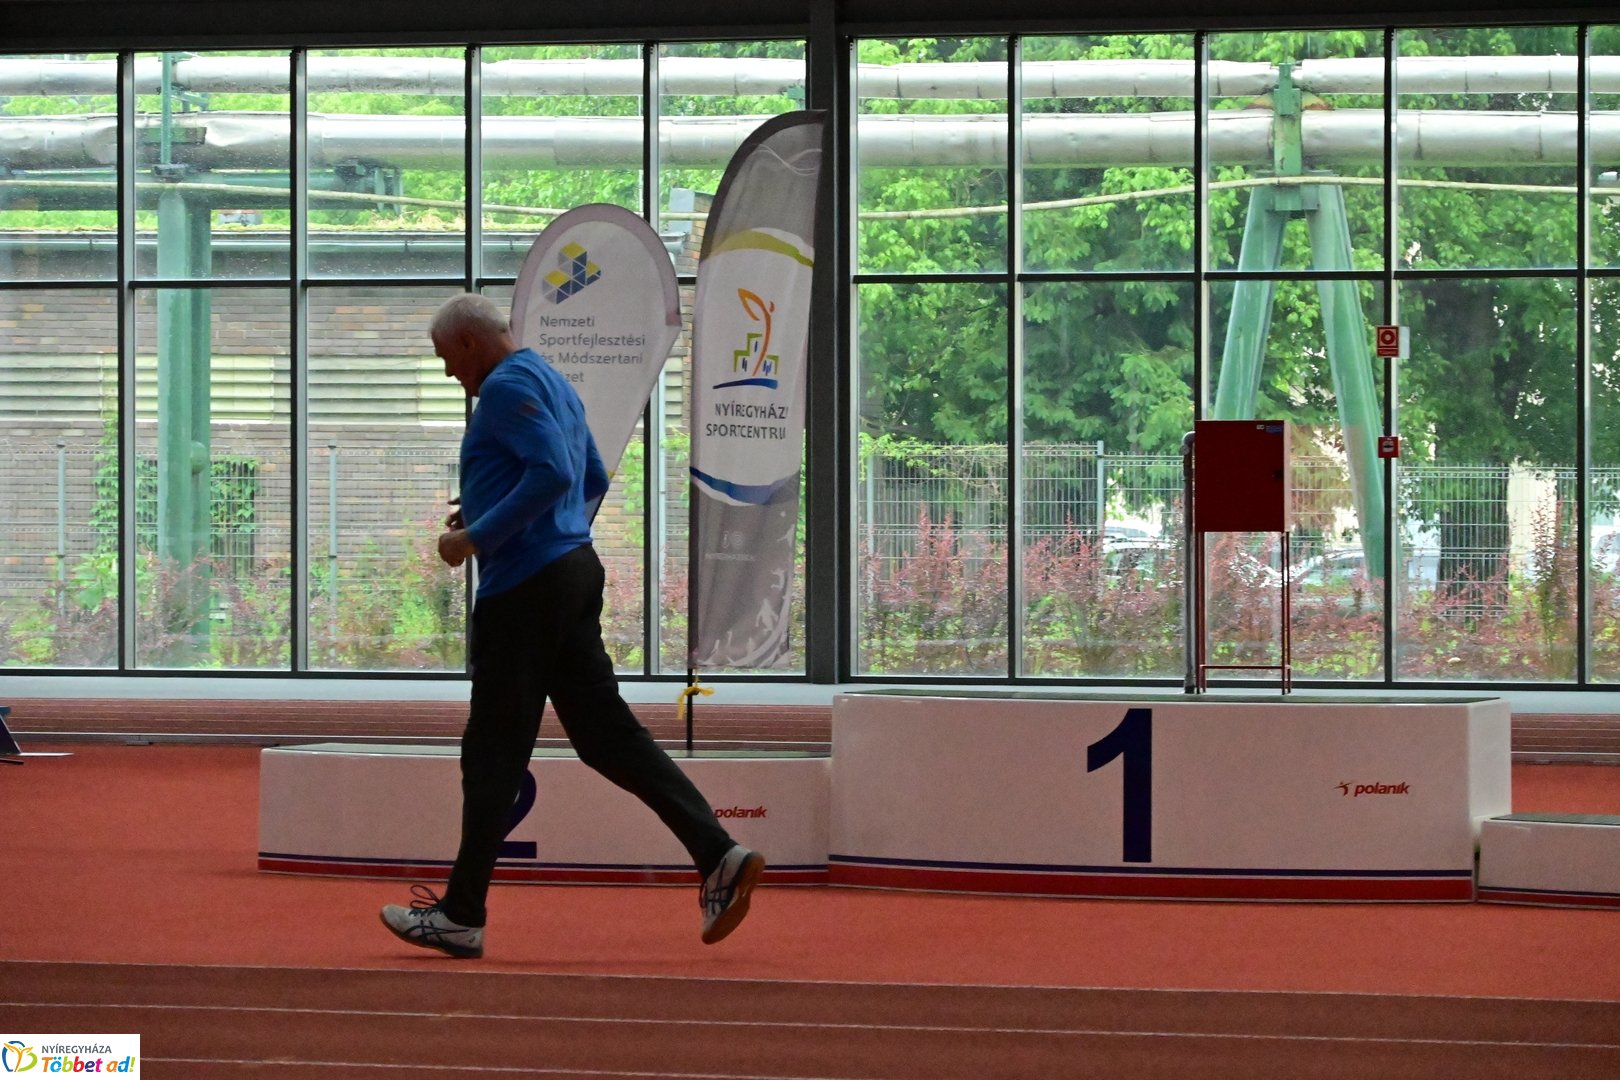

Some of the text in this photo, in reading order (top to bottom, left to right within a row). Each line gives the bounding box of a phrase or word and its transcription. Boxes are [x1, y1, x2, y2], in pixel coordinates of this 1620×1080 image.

[540, 315, 595, 327] Nemzeti
[539, 333, 646, 349] Sportfejlesztési
[558, 351, 644, 364] Módszertani
[1087, 708, 1153, 863] 1
[1353, 781, 1411, 797] polanik
